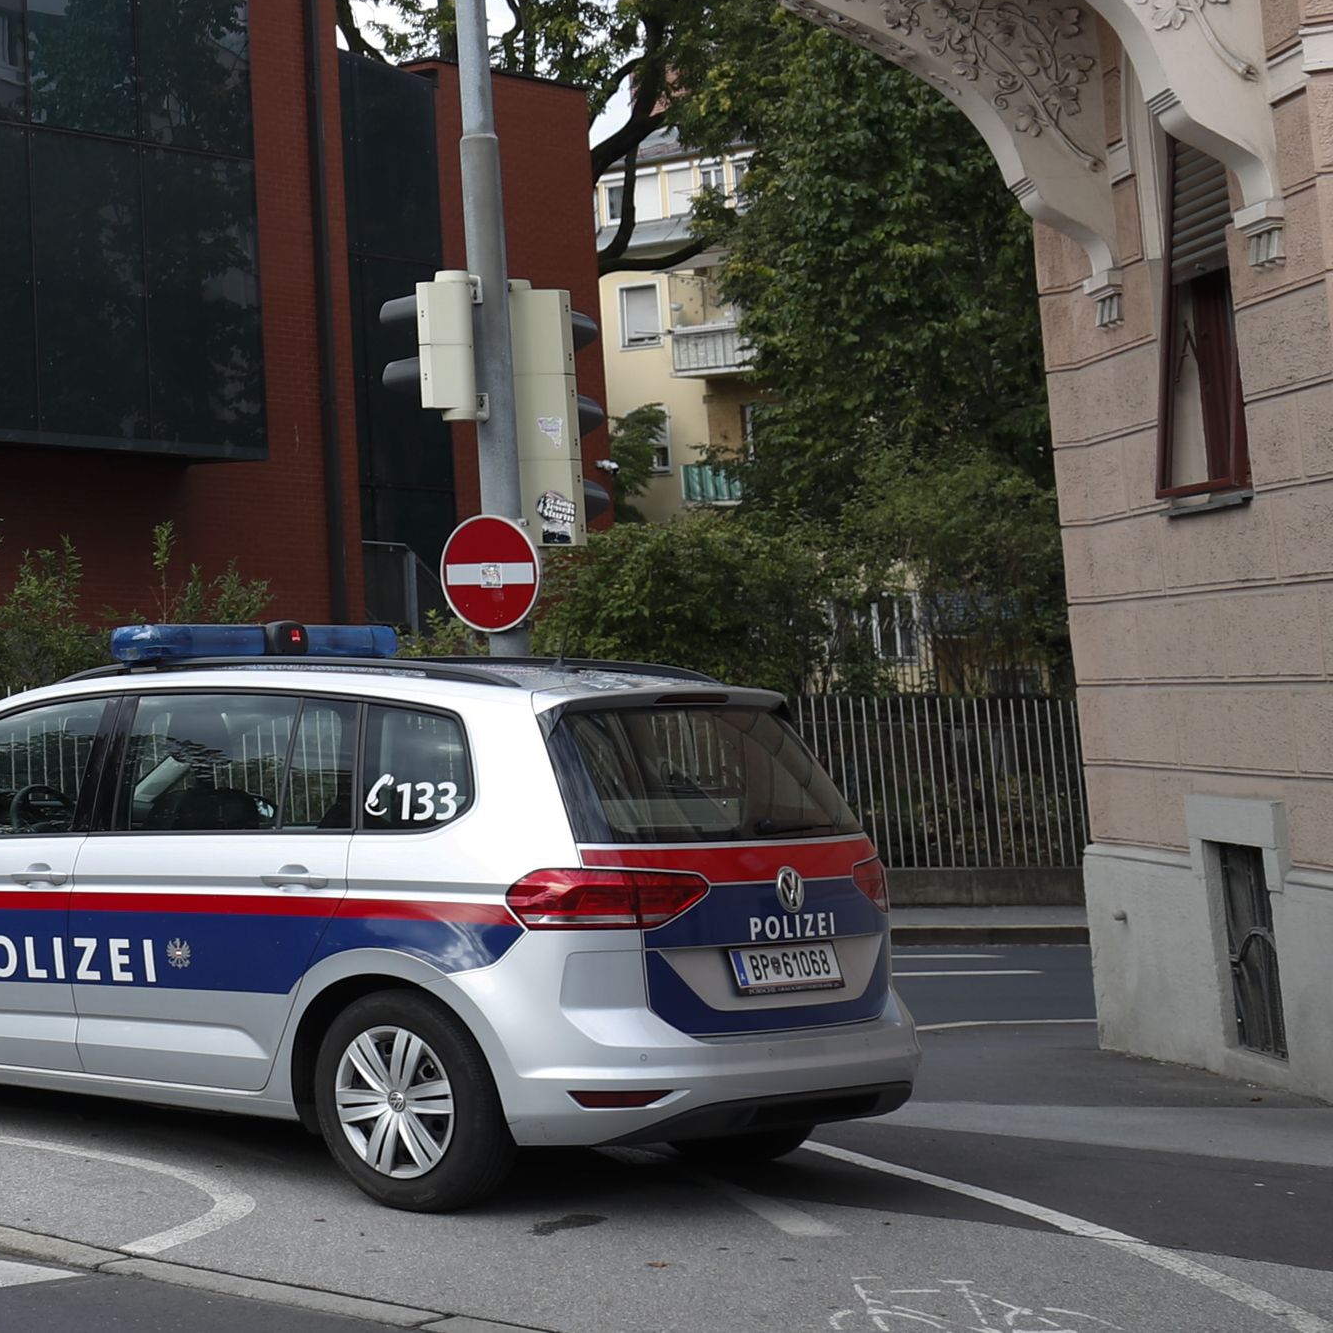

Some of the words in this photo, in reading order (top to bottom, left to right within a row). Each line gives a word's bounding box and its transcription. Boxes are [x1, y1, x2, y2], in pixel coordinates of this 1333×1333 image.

[396, 782, 457, 821] 133
[749, 912, 835, 941] POLIZEI
[749, 953, 770, 981] BP
[781, 949, 831, 978] 61068
